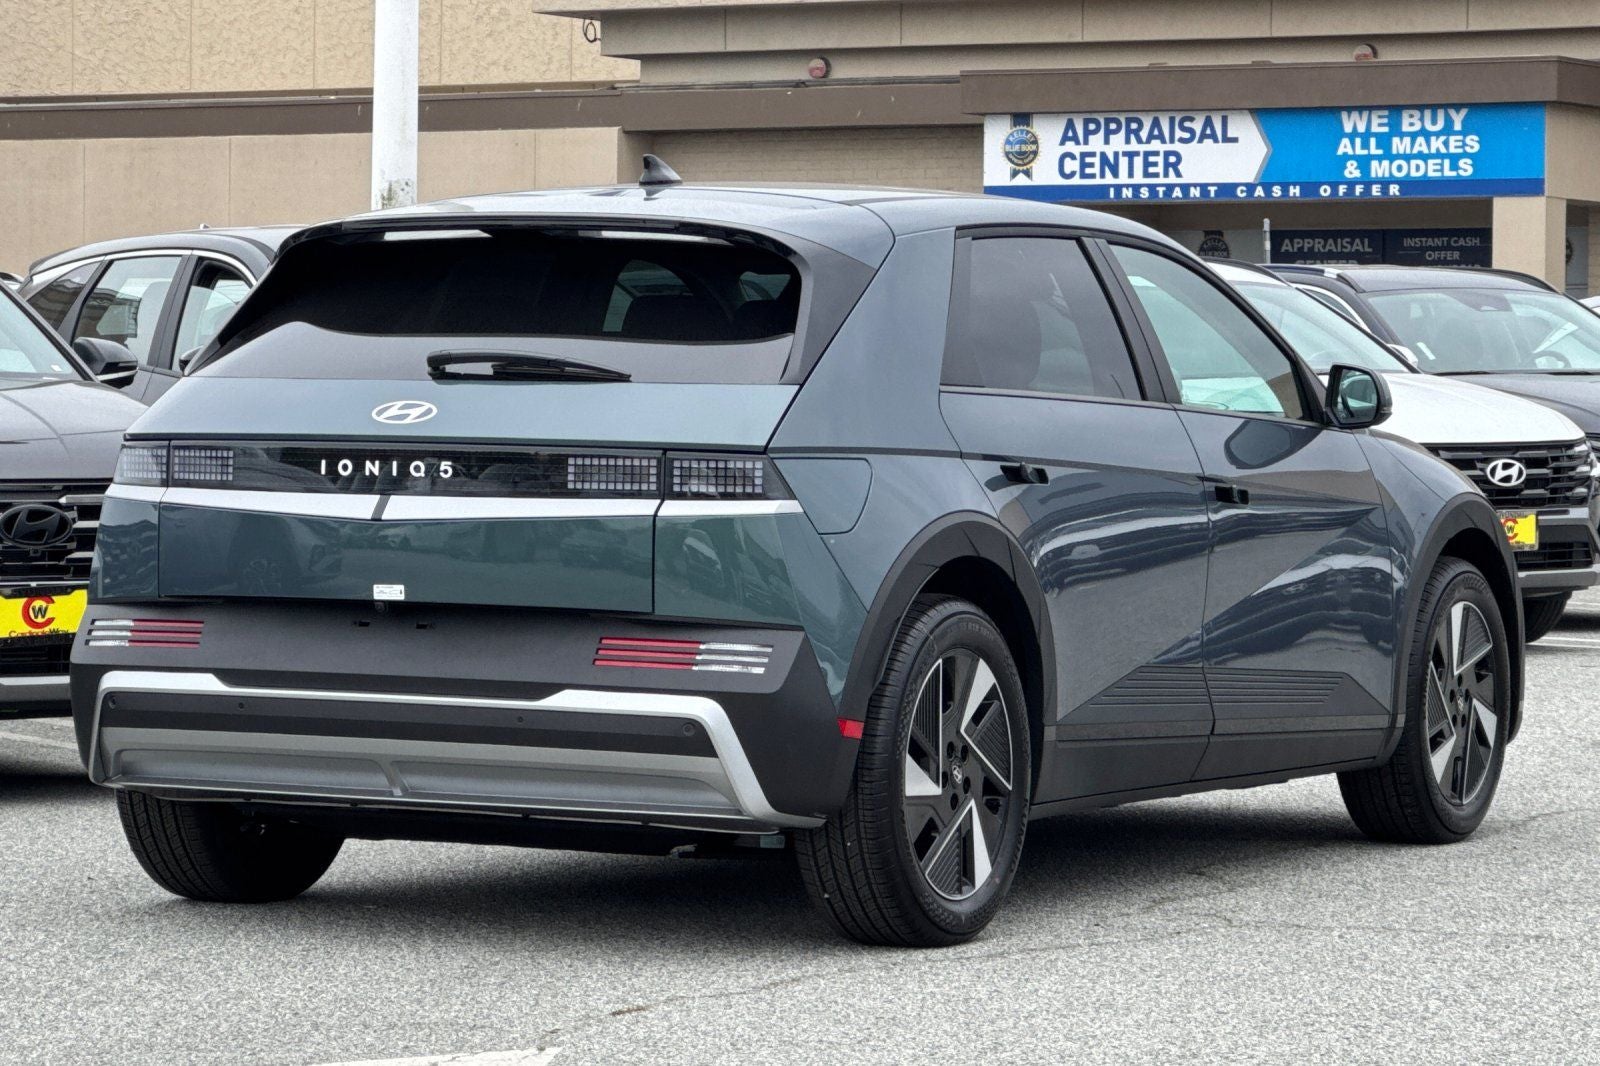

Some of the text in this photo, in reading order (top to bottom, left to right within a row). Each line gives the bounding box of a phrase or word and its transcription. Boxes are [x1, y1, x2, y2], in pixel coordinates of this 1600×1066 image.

[1058, 115, 1240, 146] APPRAISAL
[1340, 108, 1469, 133] WE BUY
[1336, 135, 1481, 155] ALL MAKES
[1057, 150, 1184, 180] CENTER
[1343, 158, 1474, 178] & MODELS
[1109, 184, 1400, 199] INSTANT CASH OFFER
[1280, 238, 1373, 253] APPRAISAL
[1403, 237, 1480, 247] INSTANT CASH
[1425, 250, 1460, 261] OFFER
